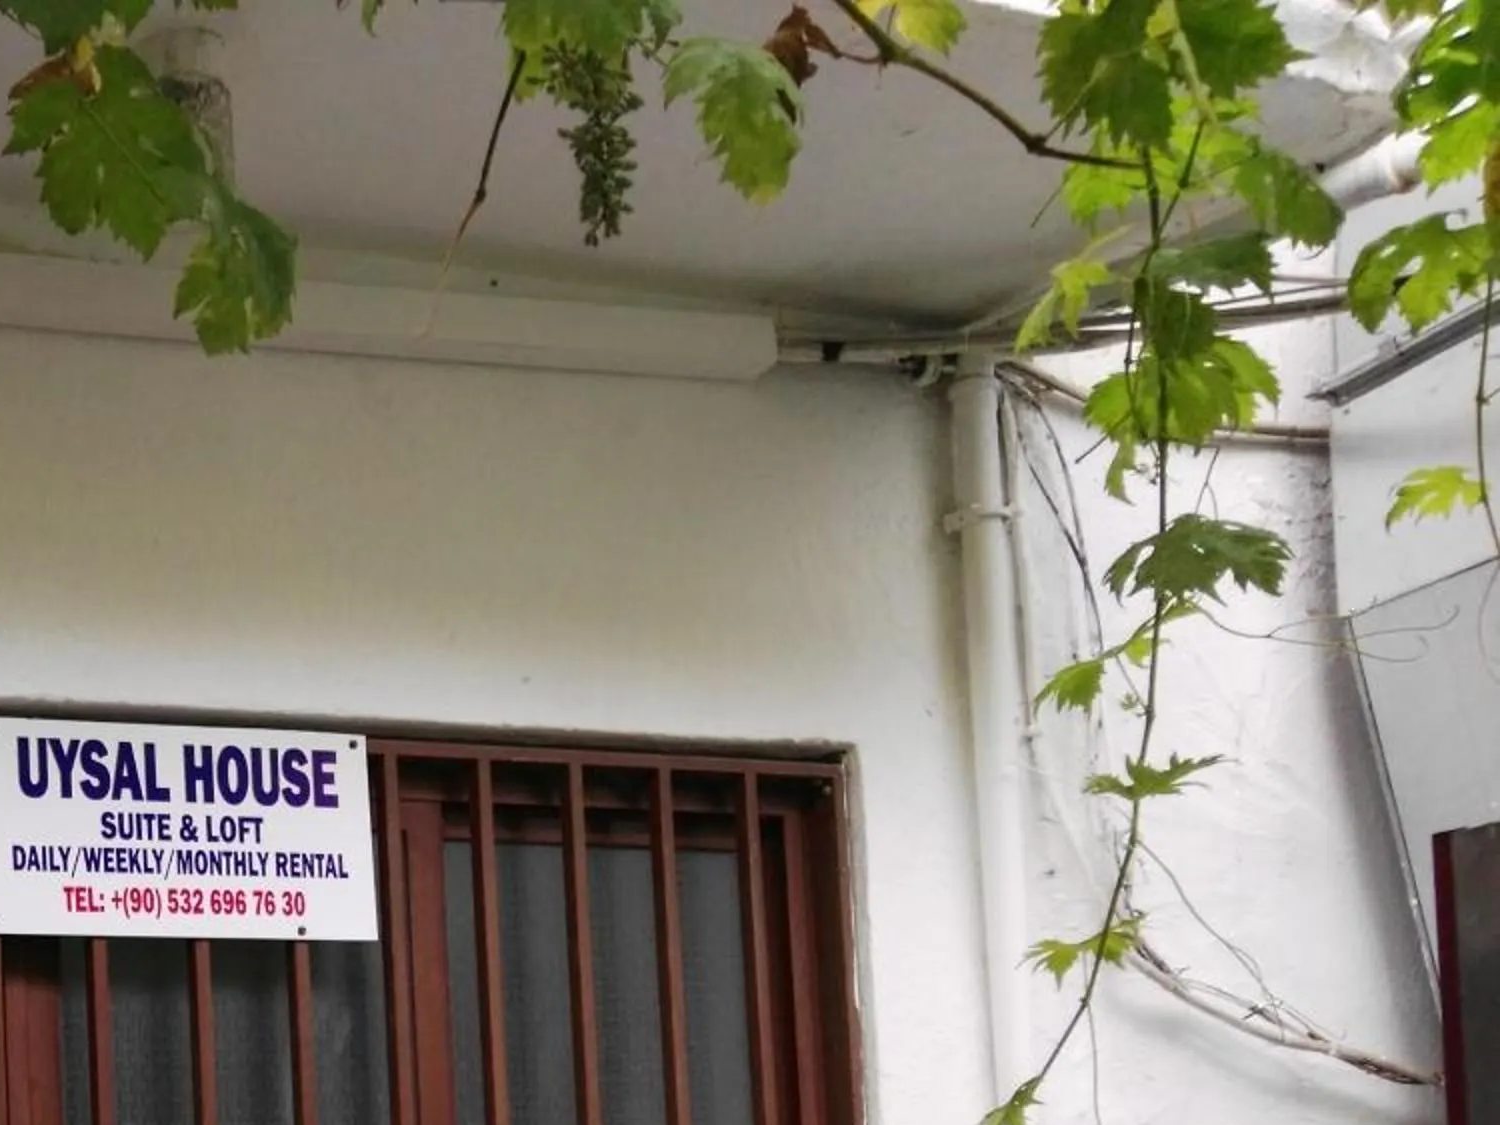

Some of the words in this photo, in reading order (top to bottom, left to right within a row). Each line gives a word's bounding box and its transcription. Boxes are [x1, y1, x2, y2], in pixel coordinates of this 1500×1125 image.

[16, 736, 171, 802] UYSAL
[183, 744, 339, 808] HOUSE
[101, 811, 172, 841] SUITE
[180, 814, 199, 842] &
[206, 815, 263, 843] LOFT
[275, 852, 349, 879] RENTAL
[63, 886, 105, 912] TEL:
[111, 887, 162, 919] +(90)
[167, 888, 204, 914] 532
[210, 889, 247, 914] 696
[252, 890, 276, 915] 76
[282, 891, 306, 916] 30
